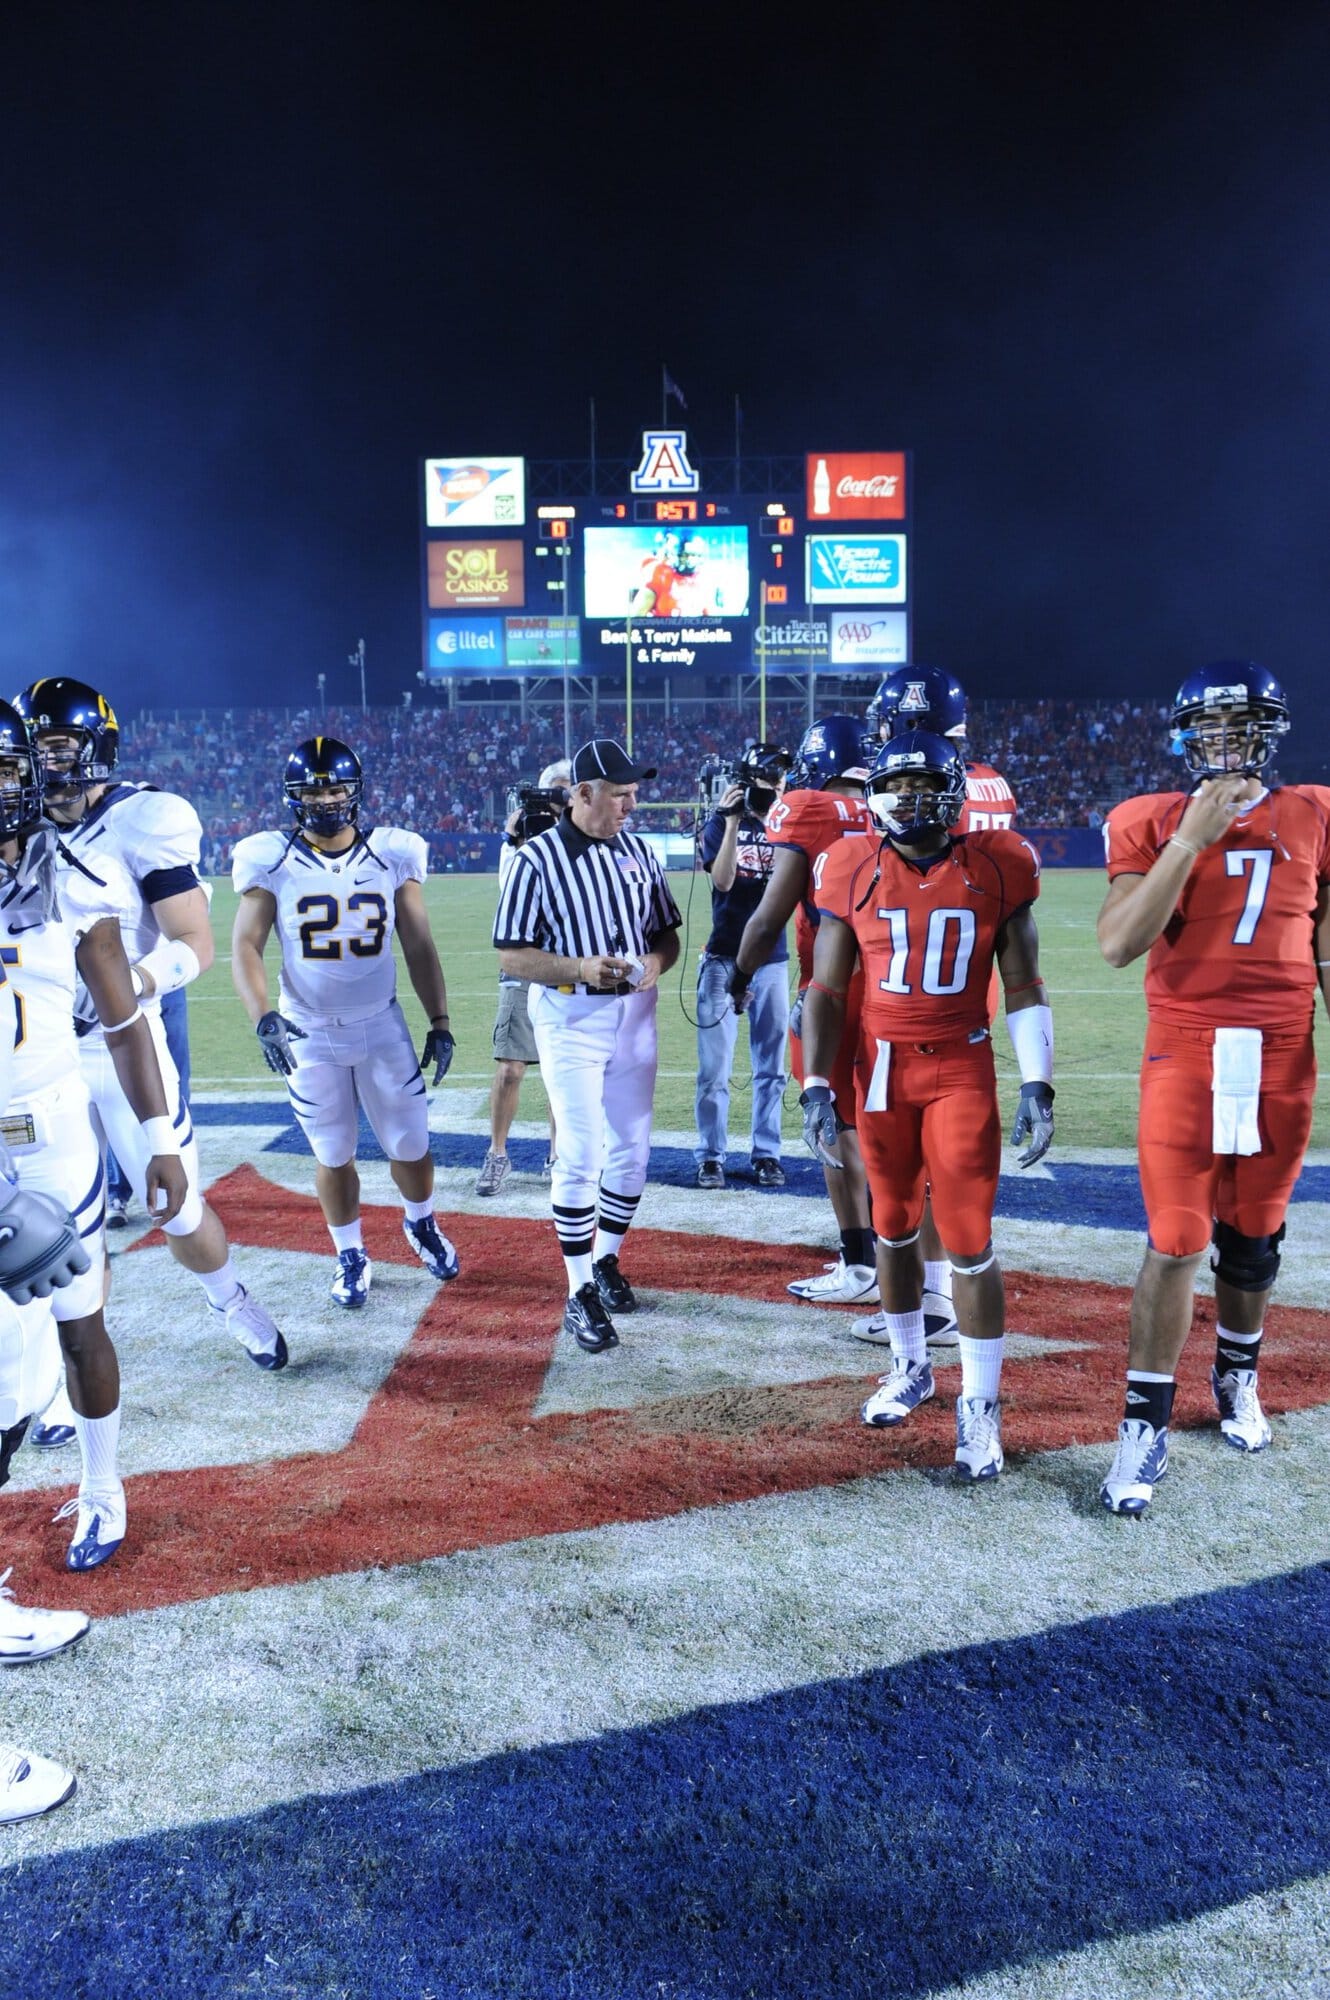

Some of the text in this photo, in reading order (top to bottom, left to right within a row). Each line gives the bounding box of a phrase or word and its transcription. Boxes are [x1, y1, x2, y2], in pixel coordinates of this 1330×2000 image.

[631, 431, 699, 493] A
[445, 549, 508, 579] SOL
[843, 571, 892, 584] Power
[445, 579, 509, 593] CASINOS
[755, 625, 828, 644] Citizen
[789, 620, 827, 630] Tucon
[1223, 848, 1273, 945] 7
[296, 893, 388, 961] 23
[877, 906, 977, 996] 10
